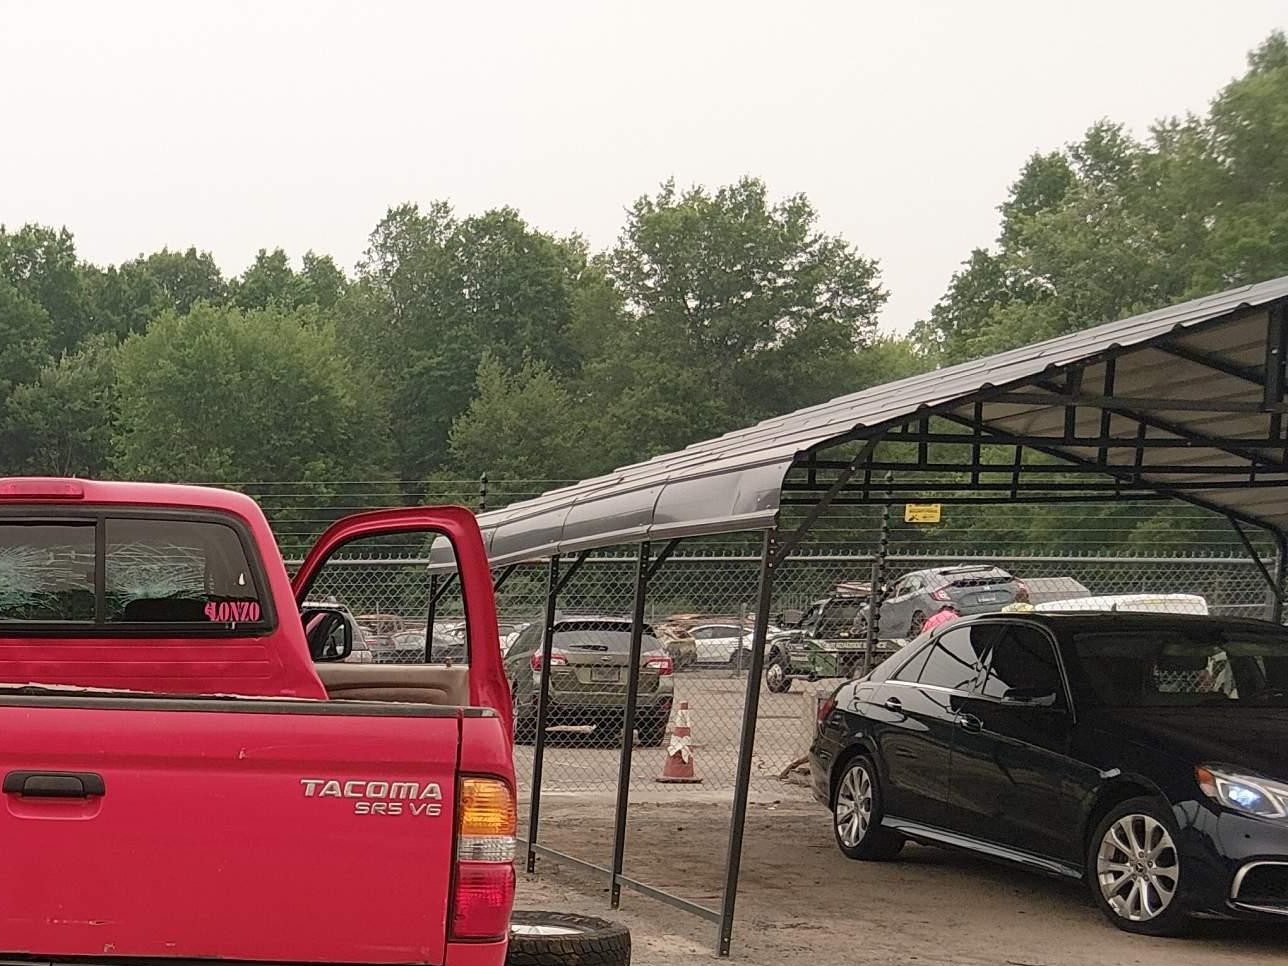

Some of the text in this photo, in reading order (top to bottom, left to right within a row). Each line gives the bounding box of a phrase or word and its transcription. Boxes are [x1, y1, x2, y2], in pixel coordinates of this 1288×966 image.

[300, 779, 443, 800] TACOMA
[354, 802, 443, 816] SR5 V6
